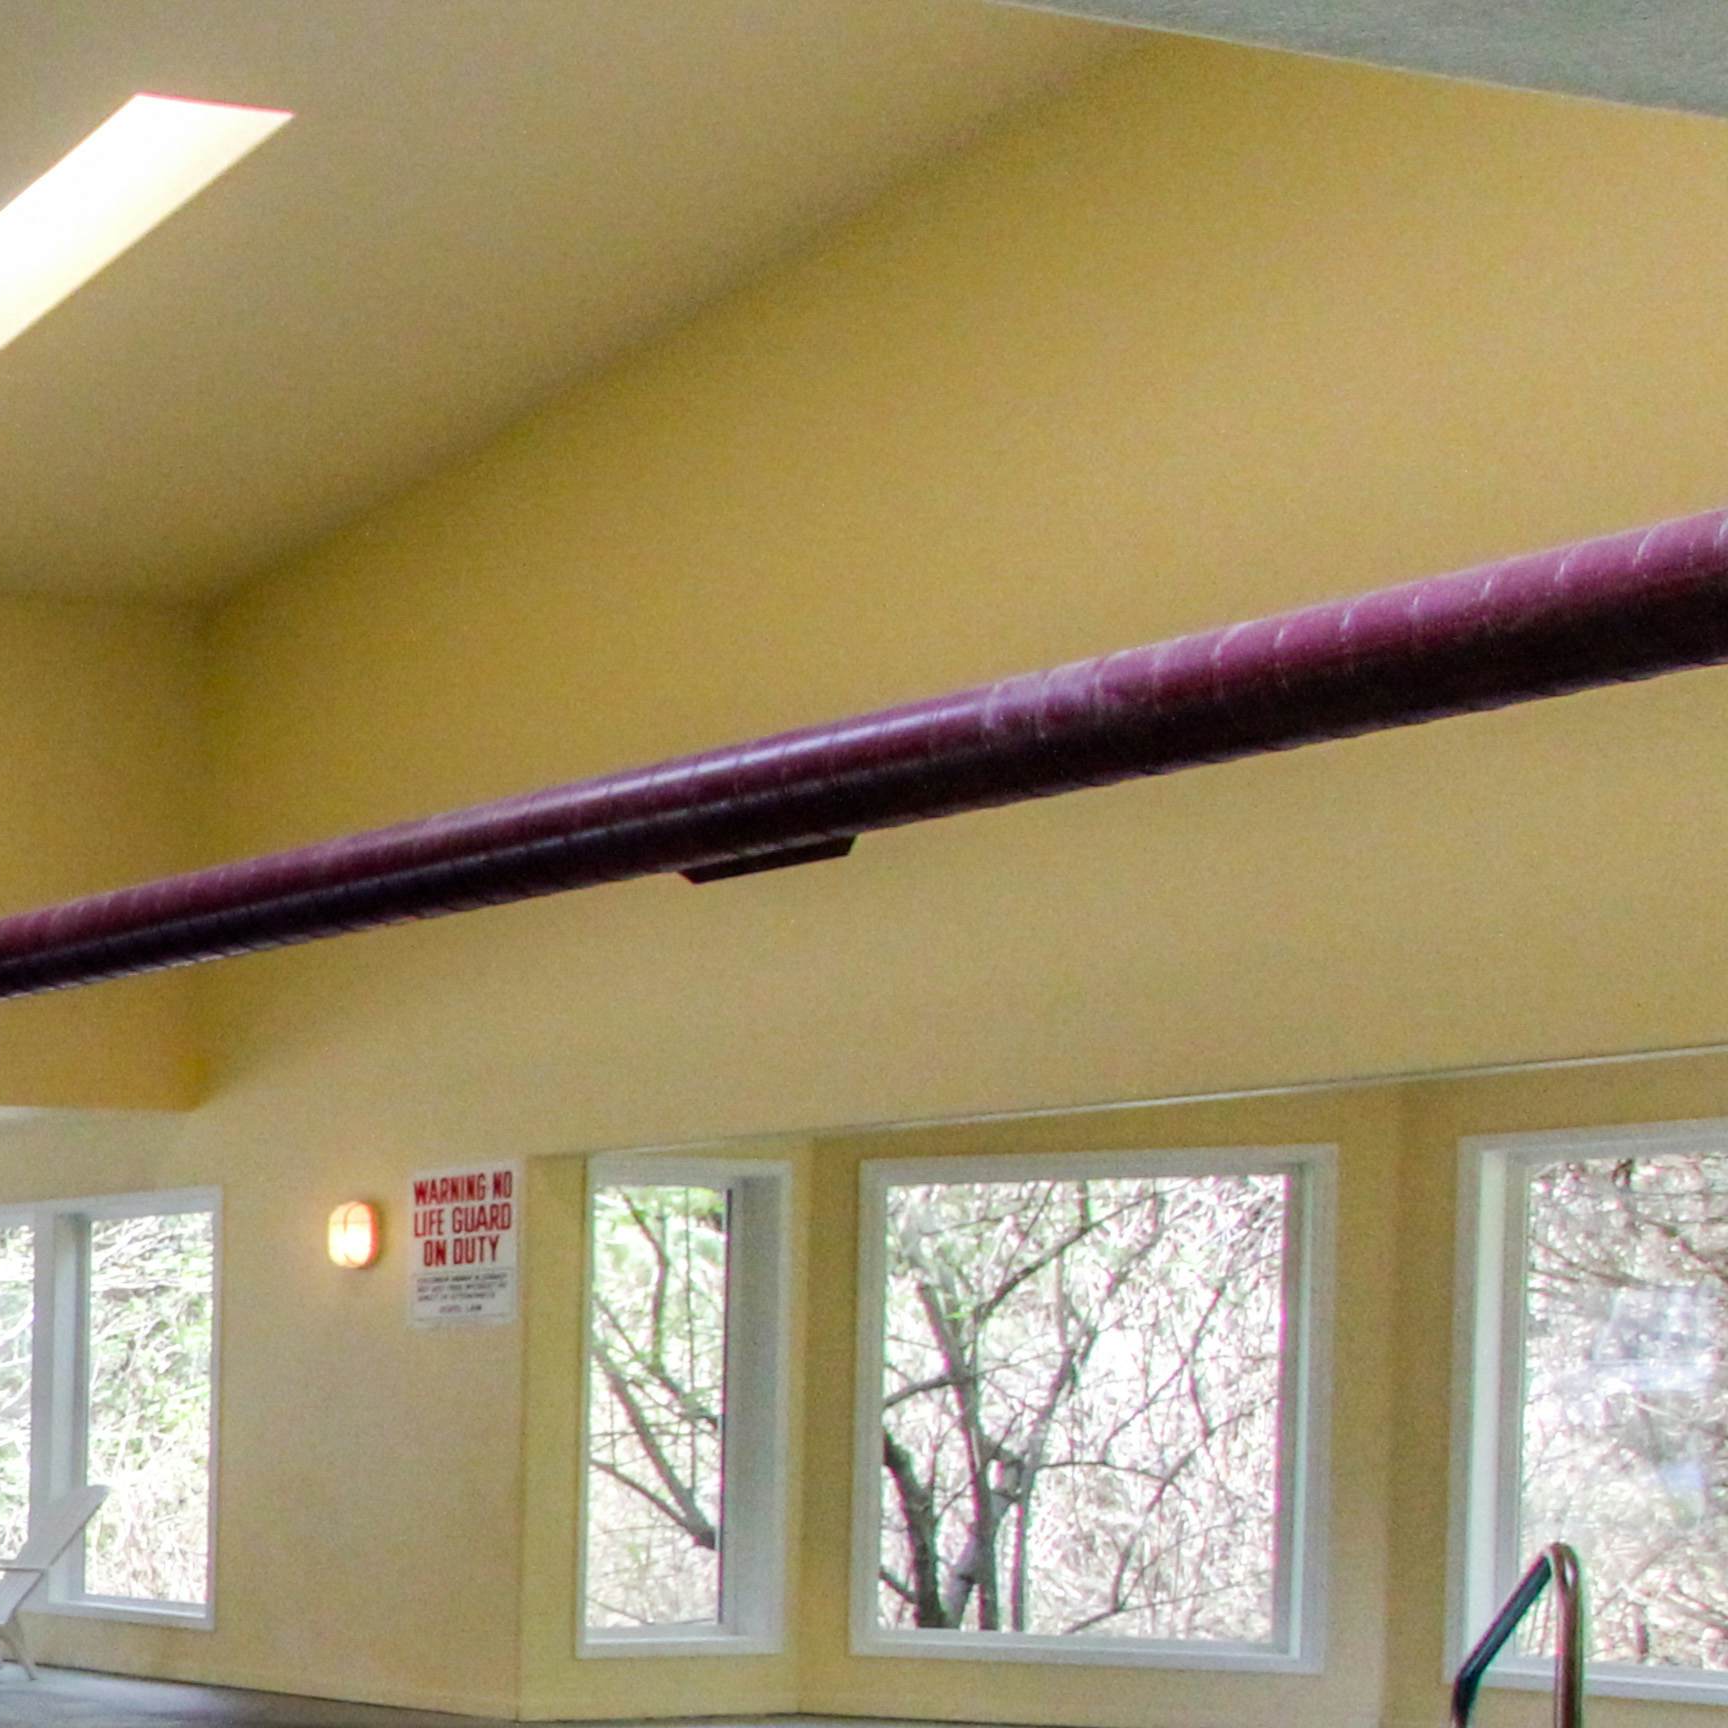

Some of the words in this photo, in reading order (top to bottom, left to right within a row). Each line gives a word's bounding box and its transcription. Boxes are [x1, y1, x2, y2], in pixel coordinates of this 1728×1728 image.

[413, 1173, 486, 1206] WARNING
[493, 1171, 512, 1199] NO
[414, 1208, 444, 1237] LIFE
[452, 1203, 511, 1235] GUARD
[423, 1240, 447, 1267] ON
[453, 1235, 500, 1265] DUTY
